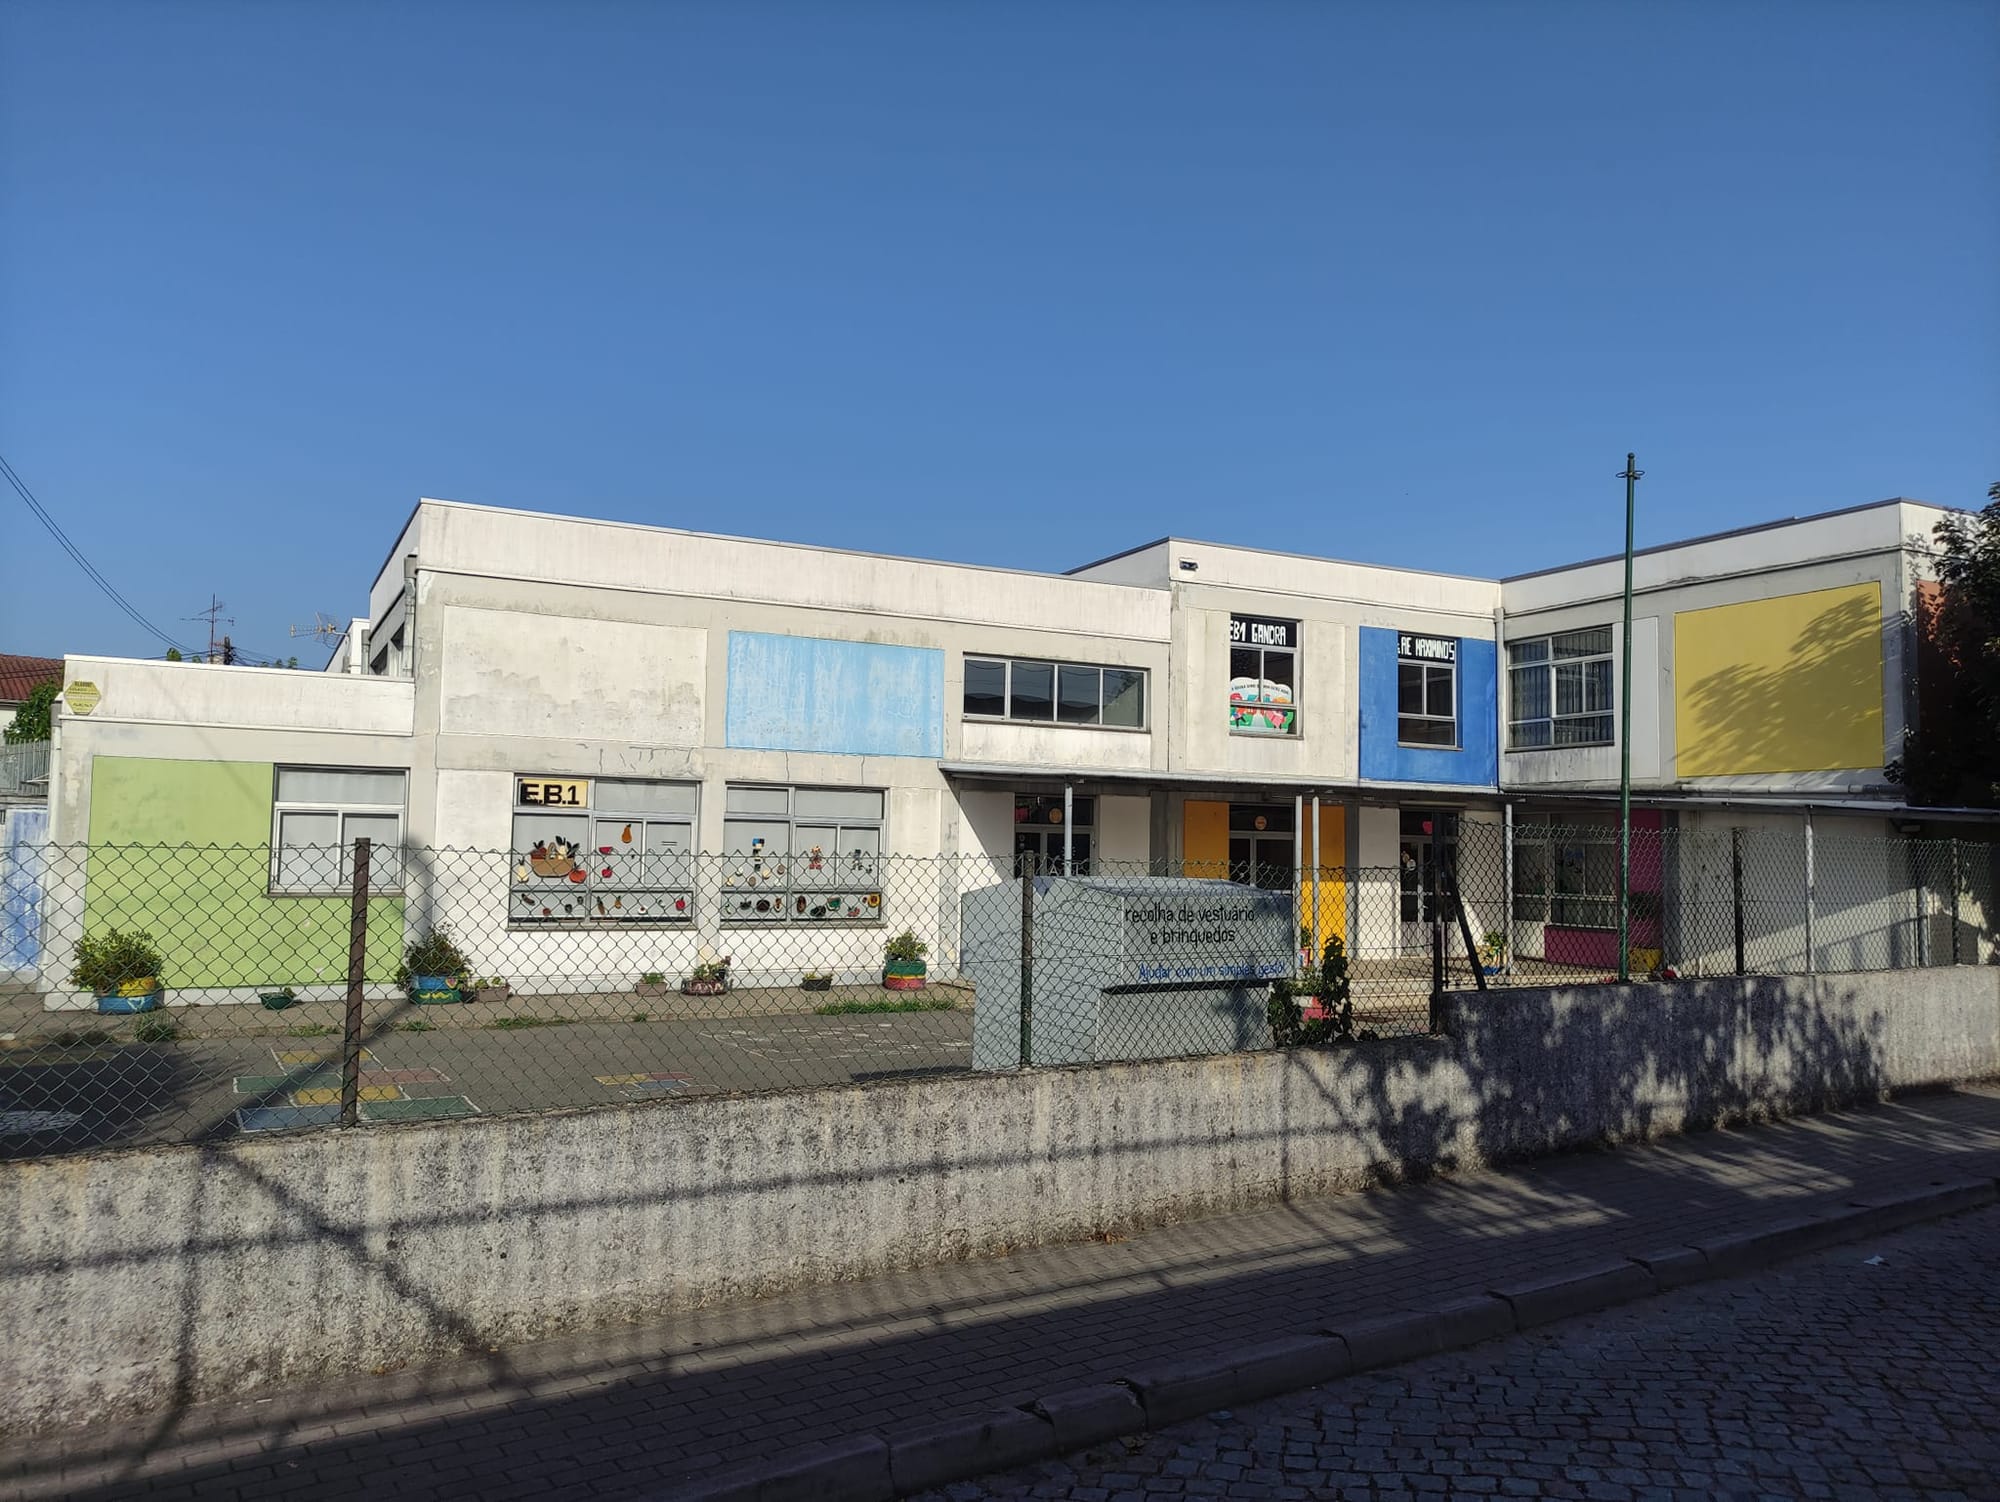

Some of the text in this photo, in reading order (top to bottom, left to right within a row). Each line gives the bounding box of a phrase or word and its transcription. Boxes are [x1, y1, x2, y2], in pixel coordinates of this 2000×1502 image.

[1251, 623, 1286, 645] GANDRA
[1415, 637, 1455, 660] MAXIMINOS
[520, 783, 579, 805] E.B.1
[1125, 902, 1254, 923] recolha de vestuário
[1151, 925, 1235, 948] e brinquedos
[1138, 963, 1170, 982] Ajudar
[1219, 960, 1255, 976] simples
